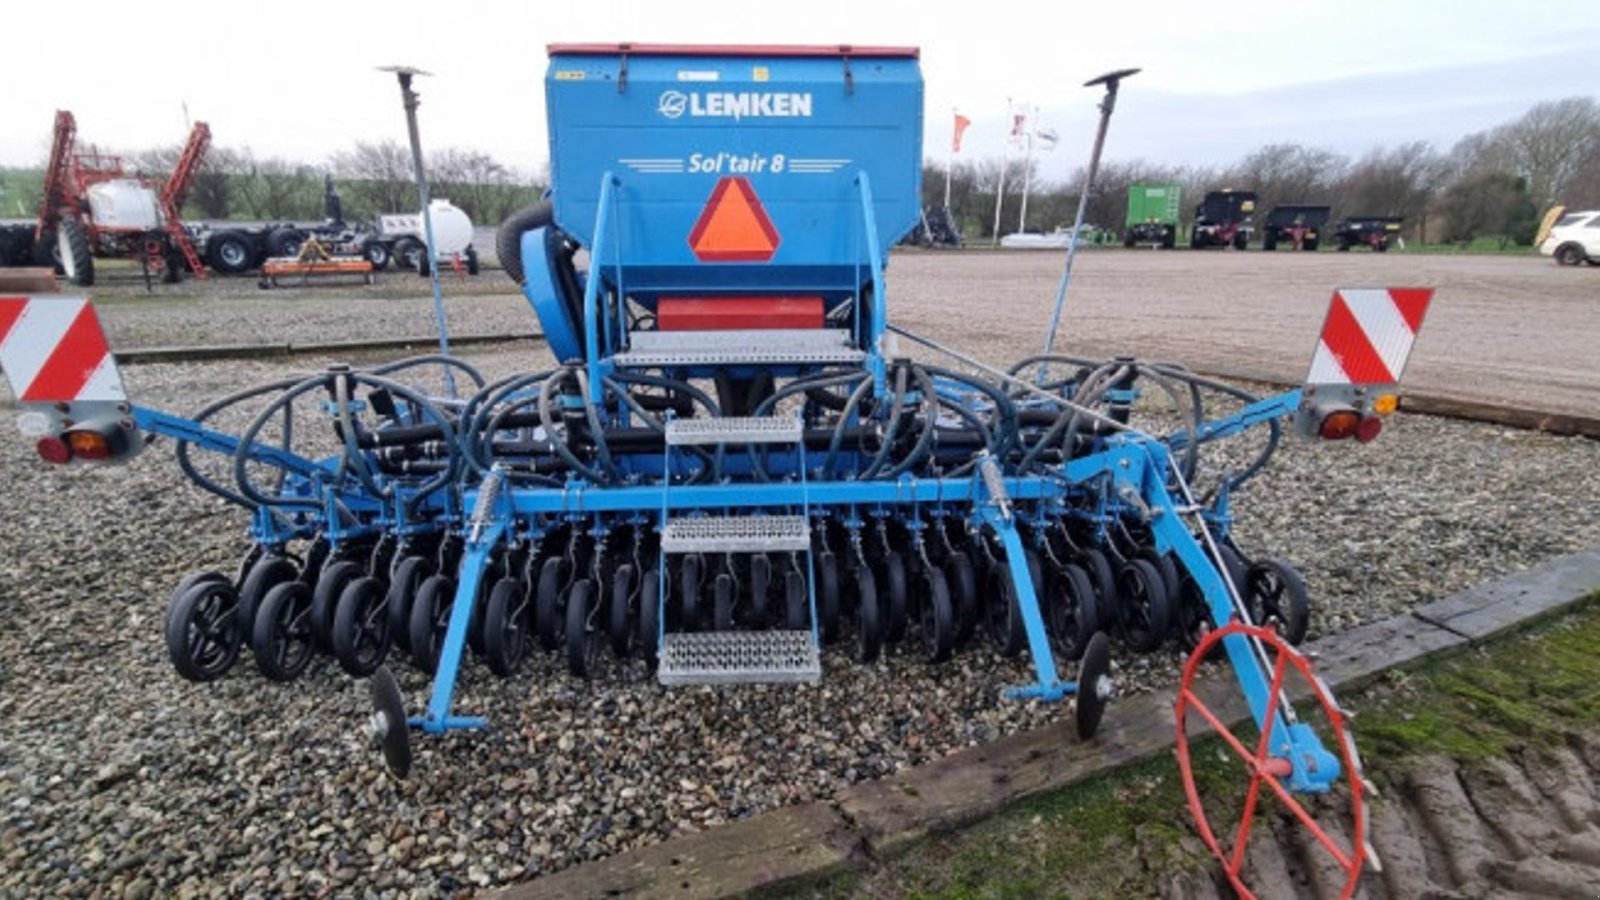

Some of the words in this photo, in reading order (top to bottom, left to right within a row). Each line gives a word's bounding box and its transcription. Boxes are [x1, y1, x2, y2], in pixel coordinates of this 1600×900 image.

[690, 93, 812, 122] LEMKEN
[688, 152, 767, 173] Soltair
[771, 154, 785, 173] 8
